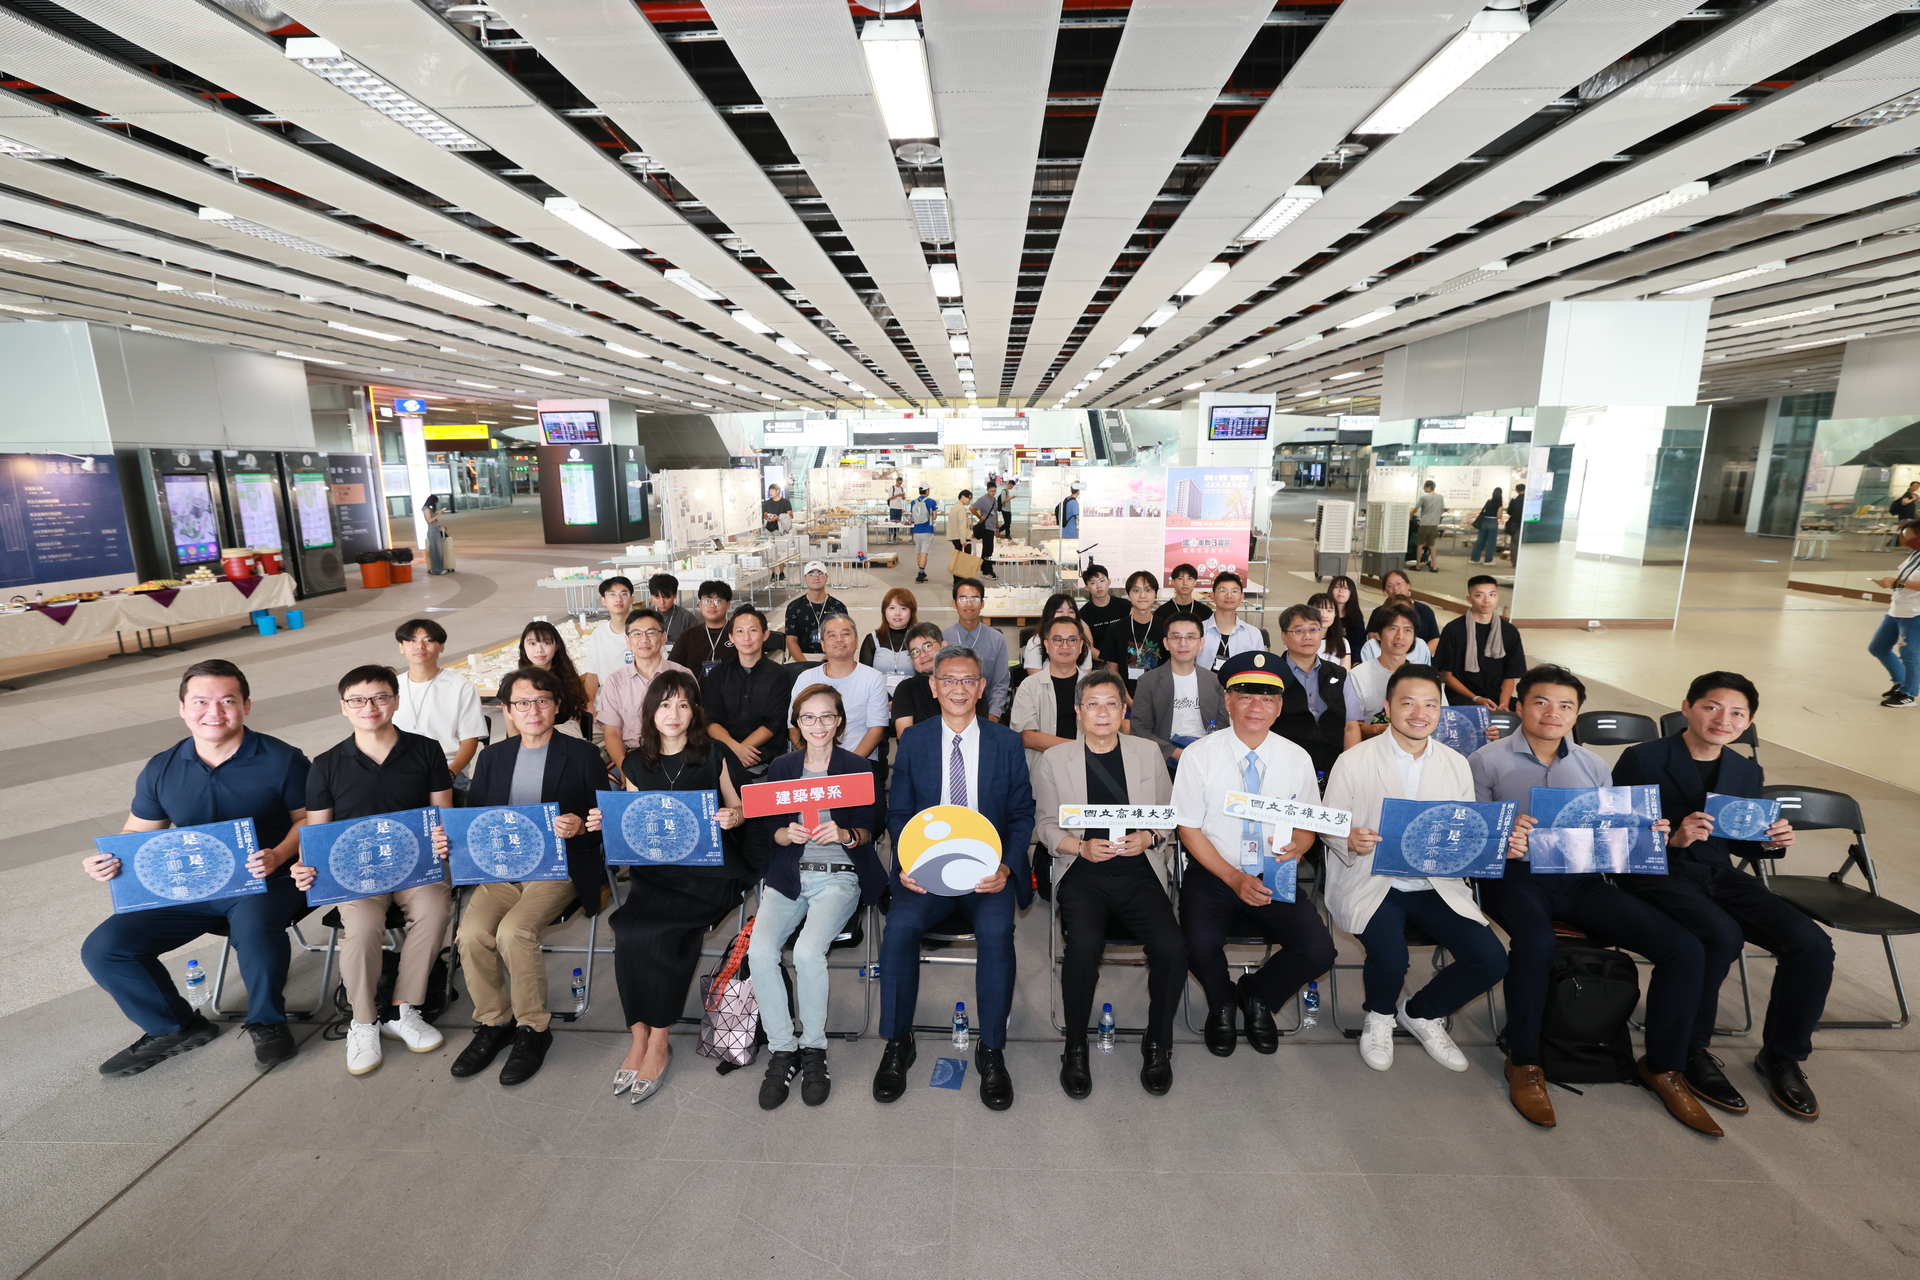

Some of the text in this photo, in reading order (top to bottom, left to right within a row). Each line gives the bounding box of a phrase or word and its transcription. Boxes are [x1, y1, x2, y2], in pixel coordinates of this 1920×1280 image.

[775, 785, 842, 806] 建築學系
[1083, 808, 1175, 820] 國立高雄大學
[1251, 799, 1349, 825] 國立高雄大學
[503, 812, 523, 856] 是一是二
[660, 797, 677, 842] 是一是二
[1249, 810, 1273, 820] National
[1275, 815, 1305, 827] University
[1315, 823, 1347, 834] Kaohsiung
[1444, 808, 1467, 853] 是一是二
[1596, 795, 1614, 842] 是一是二
[182, 833, 208, 876] 是一是二
[376, 821, 394, 868] 是一是二
